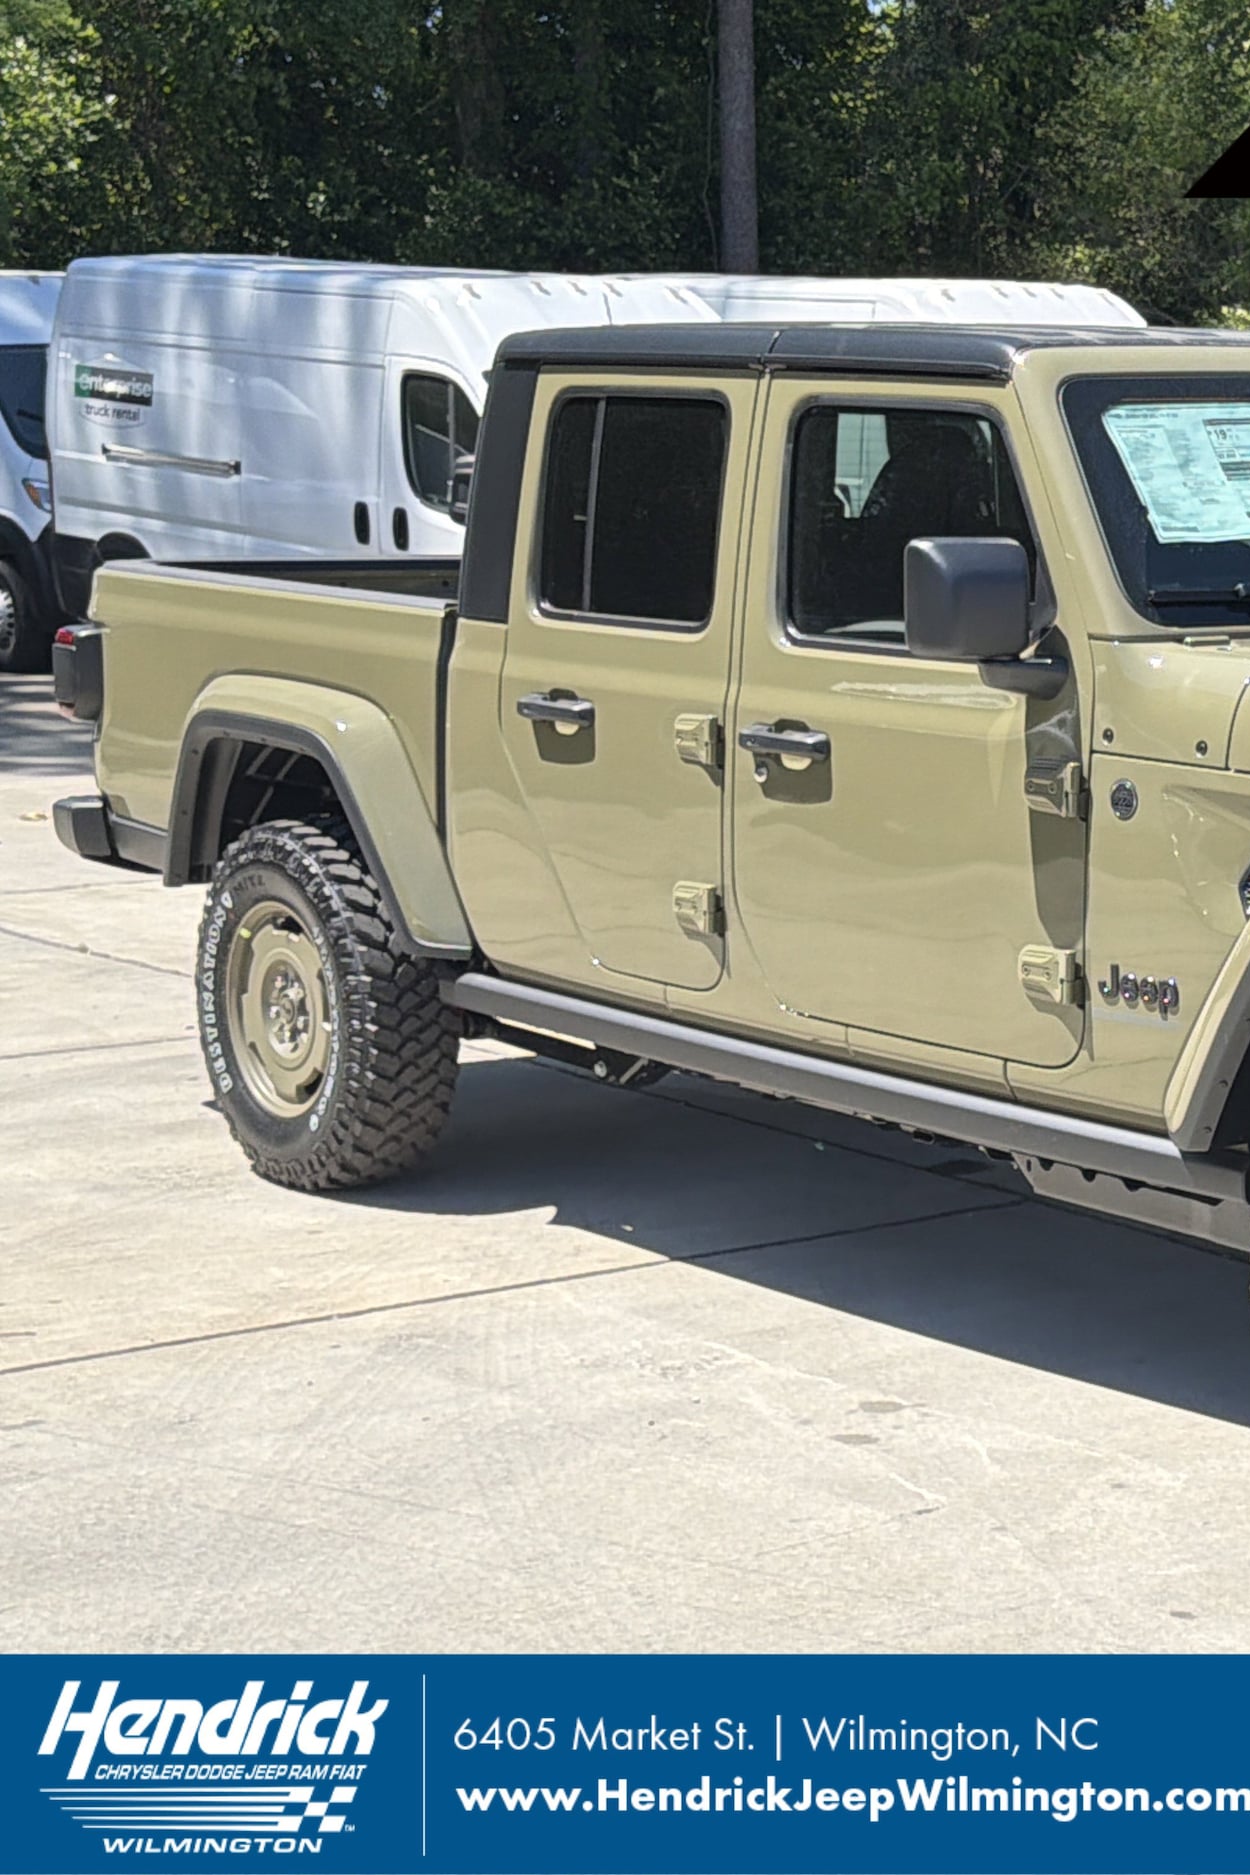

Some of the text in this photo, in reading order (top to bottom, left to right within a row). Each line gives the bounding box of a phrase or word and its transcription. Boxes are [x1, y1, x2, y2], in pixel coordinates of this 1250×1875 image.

[78, 372, 152, 398] enterprise
[85, 403, 141, 421] truck rental
[1098, 964, 1180, 1020] Jeep
